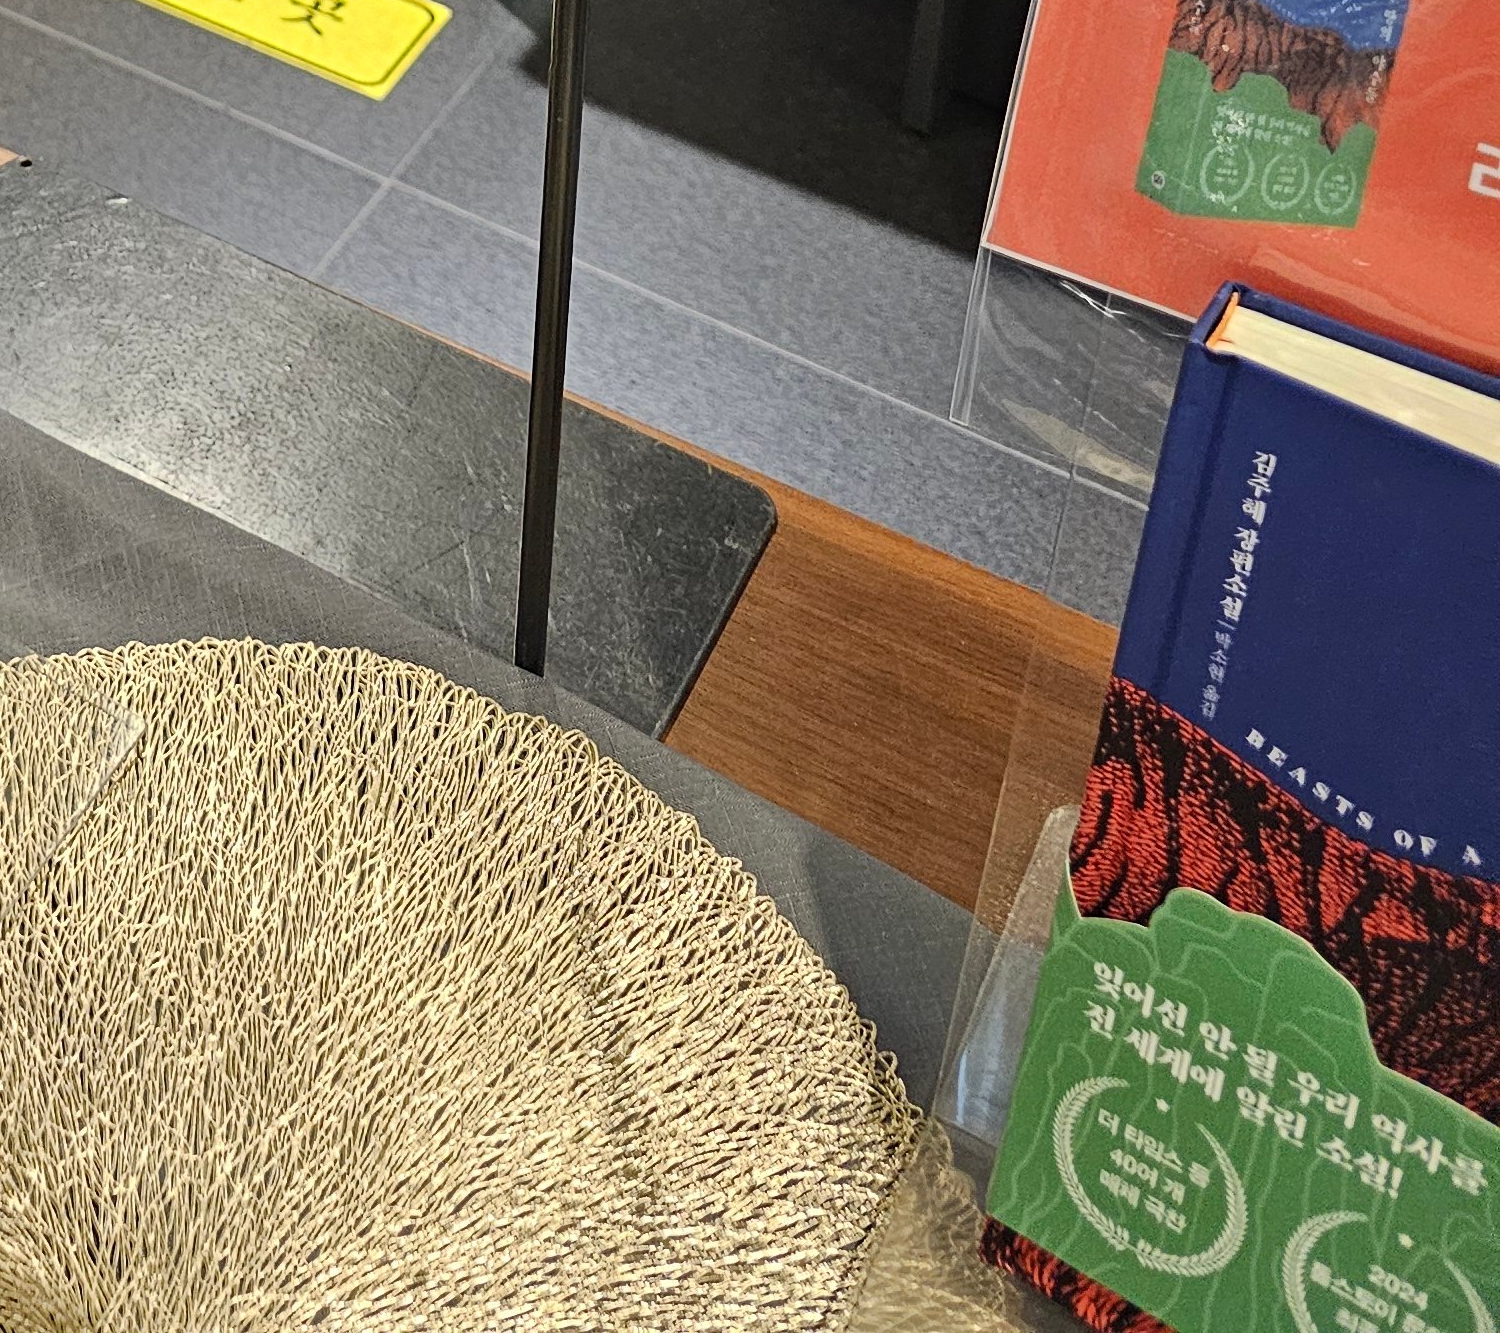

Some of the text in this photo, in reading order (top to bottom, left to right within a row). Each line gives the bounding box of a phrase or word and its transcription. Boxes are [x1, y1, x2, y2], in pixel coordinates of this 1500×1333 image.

[1242, 450, 1278, 528] 김주혜
[1220, 526, 1261, 623] 장편소설
[1244, 727, 1483, 867] BEASTS OF A
[1093, 960, 1189, 1037] 잊어선
[1199, 1020, 1238, 1062] 안
[1288, 1070, 1361, 1131] 우리
[1371, 1112, 1489, 1197] 역사를
[1098, 1107, 1121, 1137] 더
[1123, 1026, 1227, 1104] 세계에
[1315, 1135, 1405, 1200] 소설!
